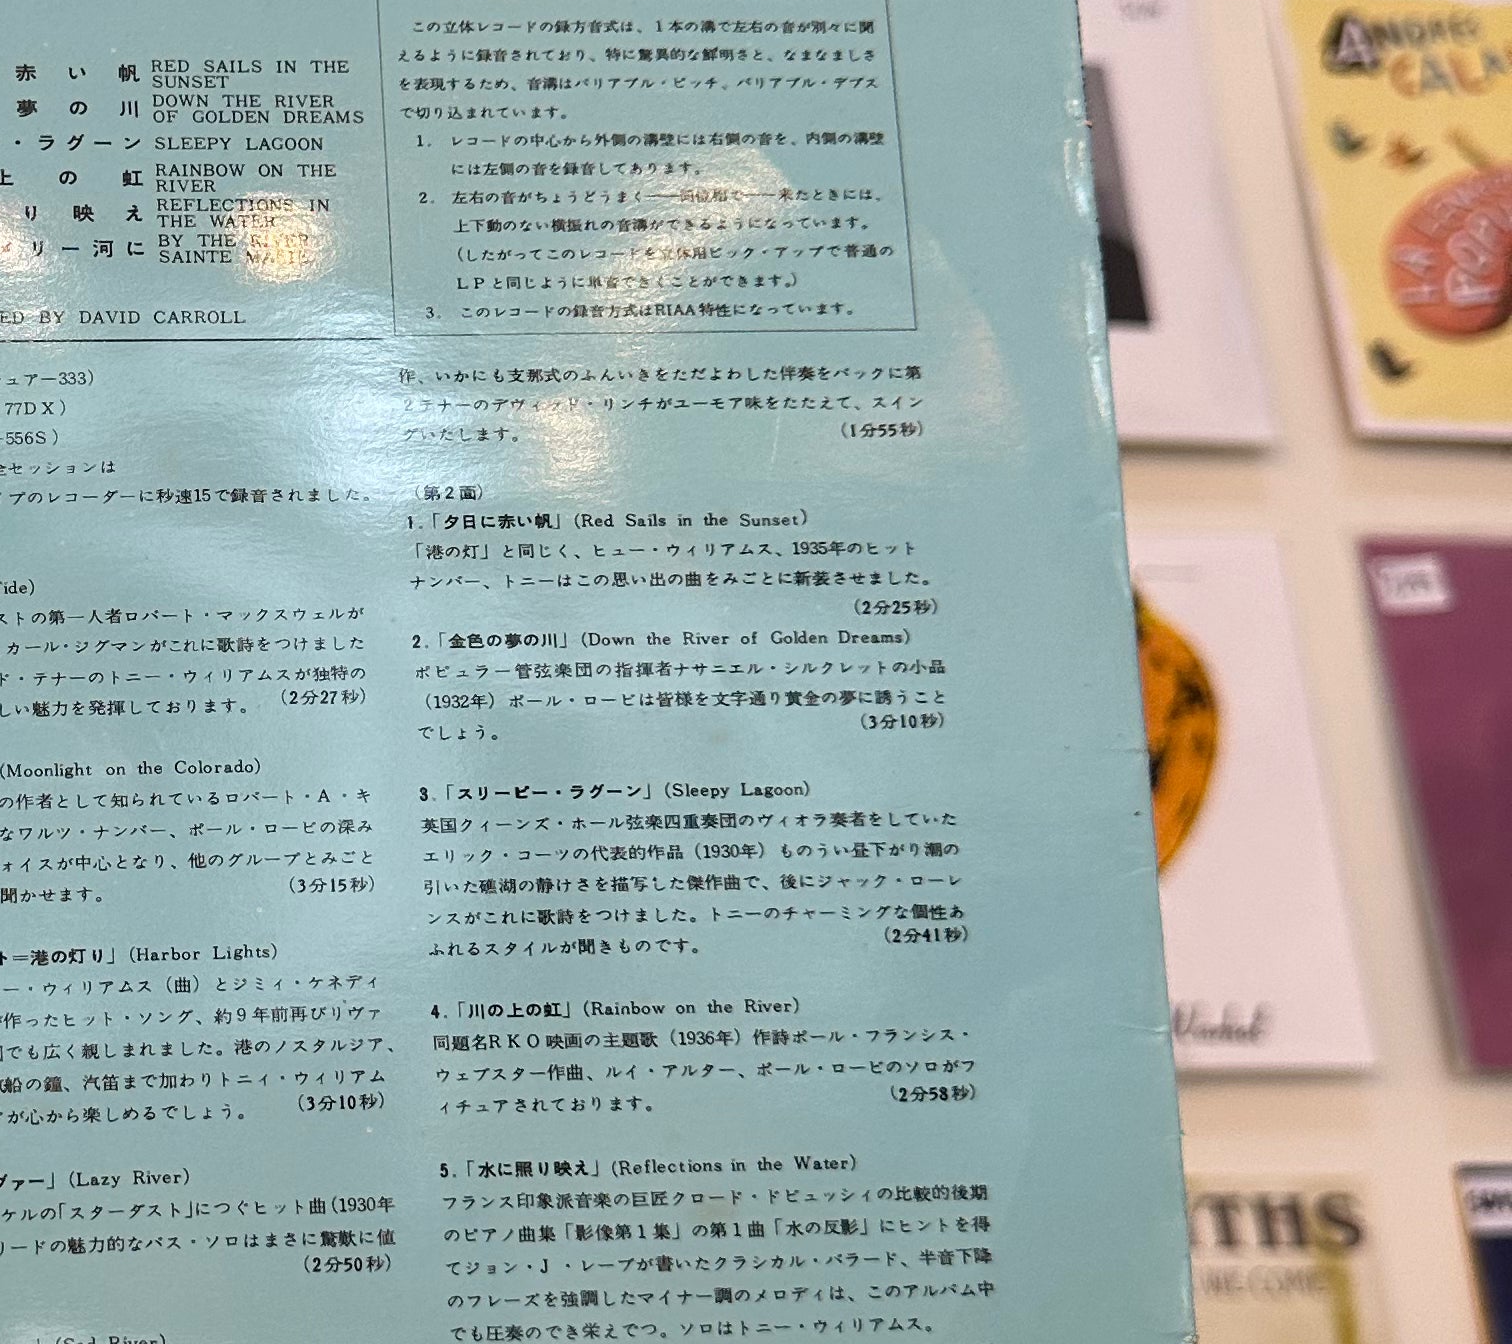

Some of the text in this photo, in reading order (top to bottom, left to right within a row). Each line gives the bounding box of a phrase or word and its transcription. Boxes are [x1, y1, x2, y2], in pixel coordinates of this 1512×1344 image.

[152, 60, 349, 73] RED SAILS IN THE
[152, 75, 229, 88] SUNSET
[153, 94, 334, 108] DOWN THE RIVER
[153, 110, 364, 124] OF GOLDEN DREAMS
[400, 106, 566, 120] で切り込まれています。
[155, 137, 323, 151] SLEEPY LAGOON
[156, 164, 336, 177] RAINBOW ON THE
[156, 179, 216, 192] RIVER
[157, 197, 330, 213] REFLECTIONS IN
[157, 213, 277, 229] THE WATER
[158, 233, 186, 248] BY
[198, 233, 237, 248] THE
[160, 248, 233, 265] SAINTE
[39, 309, 65, 325] BY
[79, 311, 140, 324] DAVID
[154, 311, 246, 324] CARROLL
[574, 513, 614, 529] (Red
[626, 513, 666, 527] Sails
[677, 514, 692, 526] in
[704, 512, 728, 526] the
[740, 509, 807, 527] Sunset)
[854, 598, 938, 615] (2分25秒)
[282, 687, 365, 706] (2分27秒)
[0, 762, 92, 780] (Moonlight
[106, 766, 125, 775] on
[137, 761, 162, 775] the
[175, 758, 260, 774] Colorado)
[665, 782, 730, 799] (Sleepy
[741, 781, 810, 798] Lagoon)
[612, 1159, 722, 1178] (Reflections
[731, 1159, 746, 1172] in
[757, 1157, 782, 1171] the
[794, 1154, 857, 1171] Water)
[1190, 1191, 1364, 1249] THS
